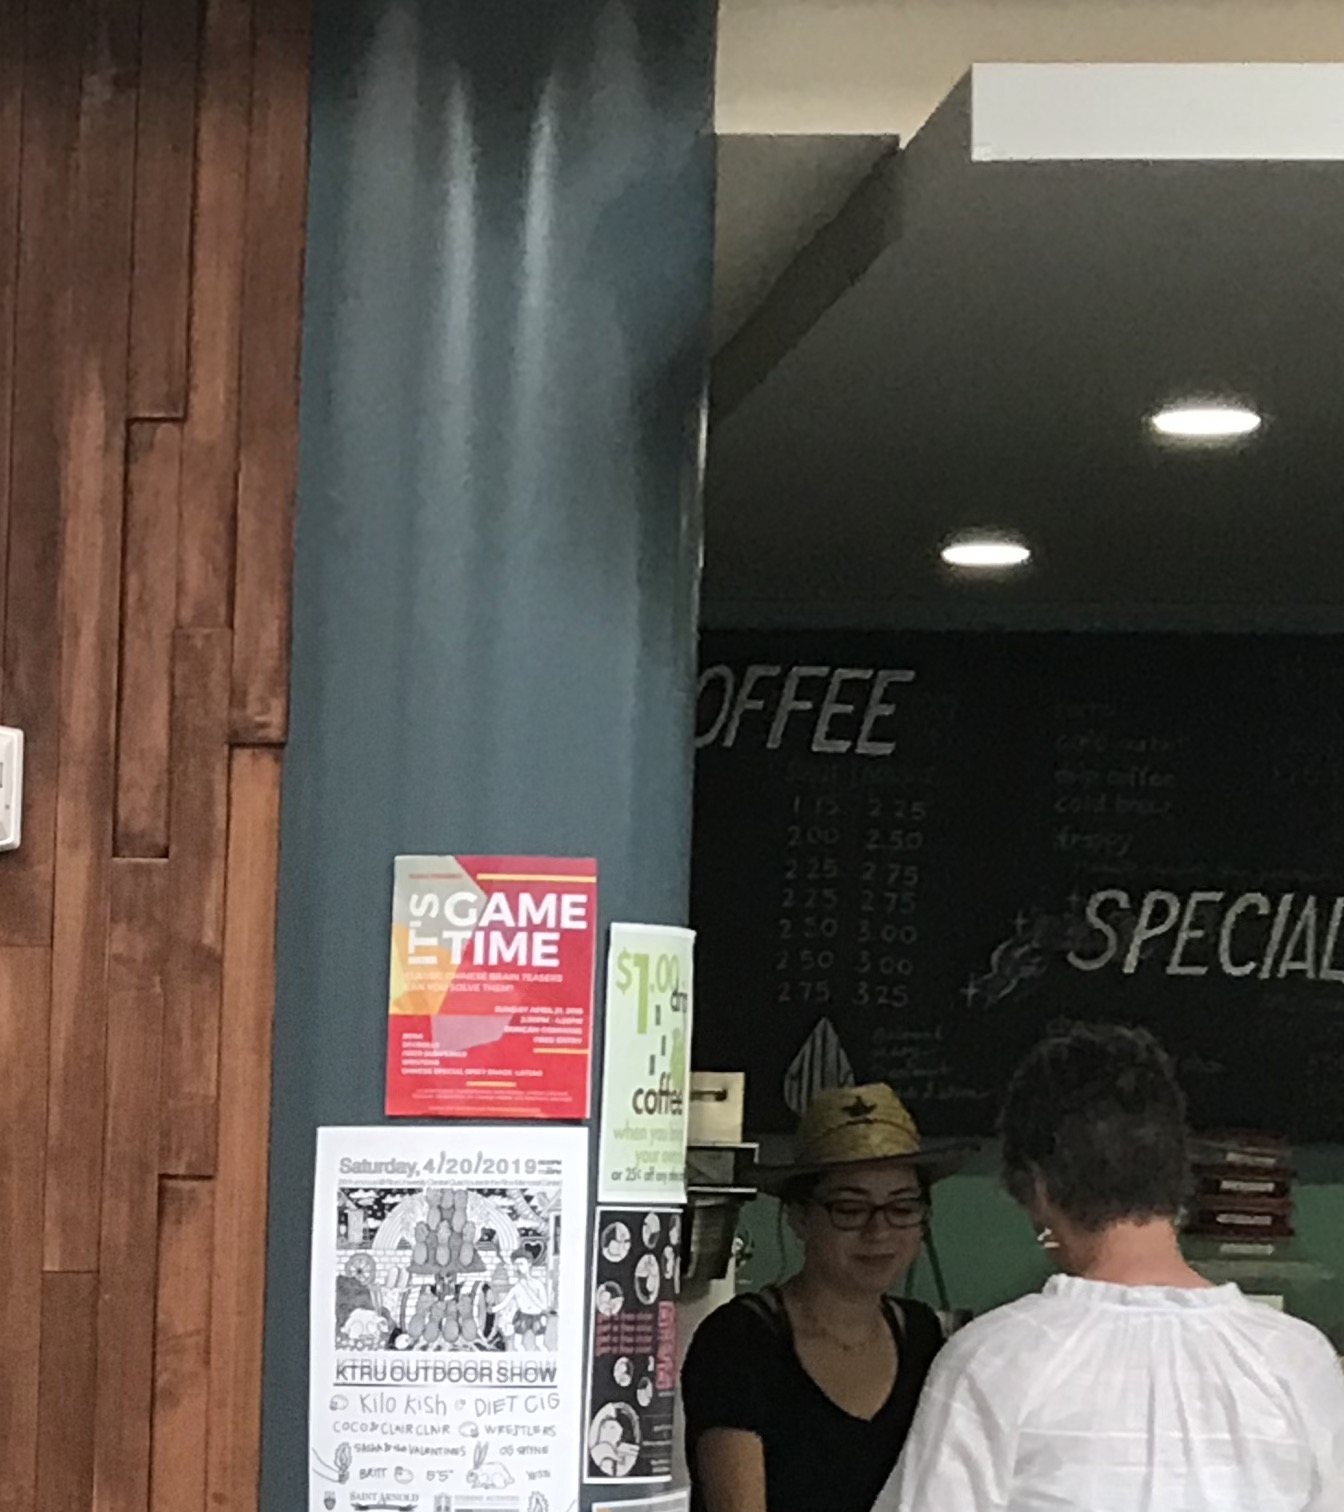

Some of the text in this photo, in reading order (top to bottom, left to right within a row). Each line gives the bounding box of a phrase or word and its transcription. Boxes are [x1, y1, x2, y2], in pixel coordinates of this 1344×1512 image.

[444, 891, 588, 930] GAME
[442, 930, 561, 967] TIME
[339, 1156, 421, 1178] Saturday,
[335, 1361, 558, 1384] KTRU OUTDOOR SHOW
[475, 1395, 520, 1418] DIET
[484, 1424, 557, 1437] WRESTLERS
